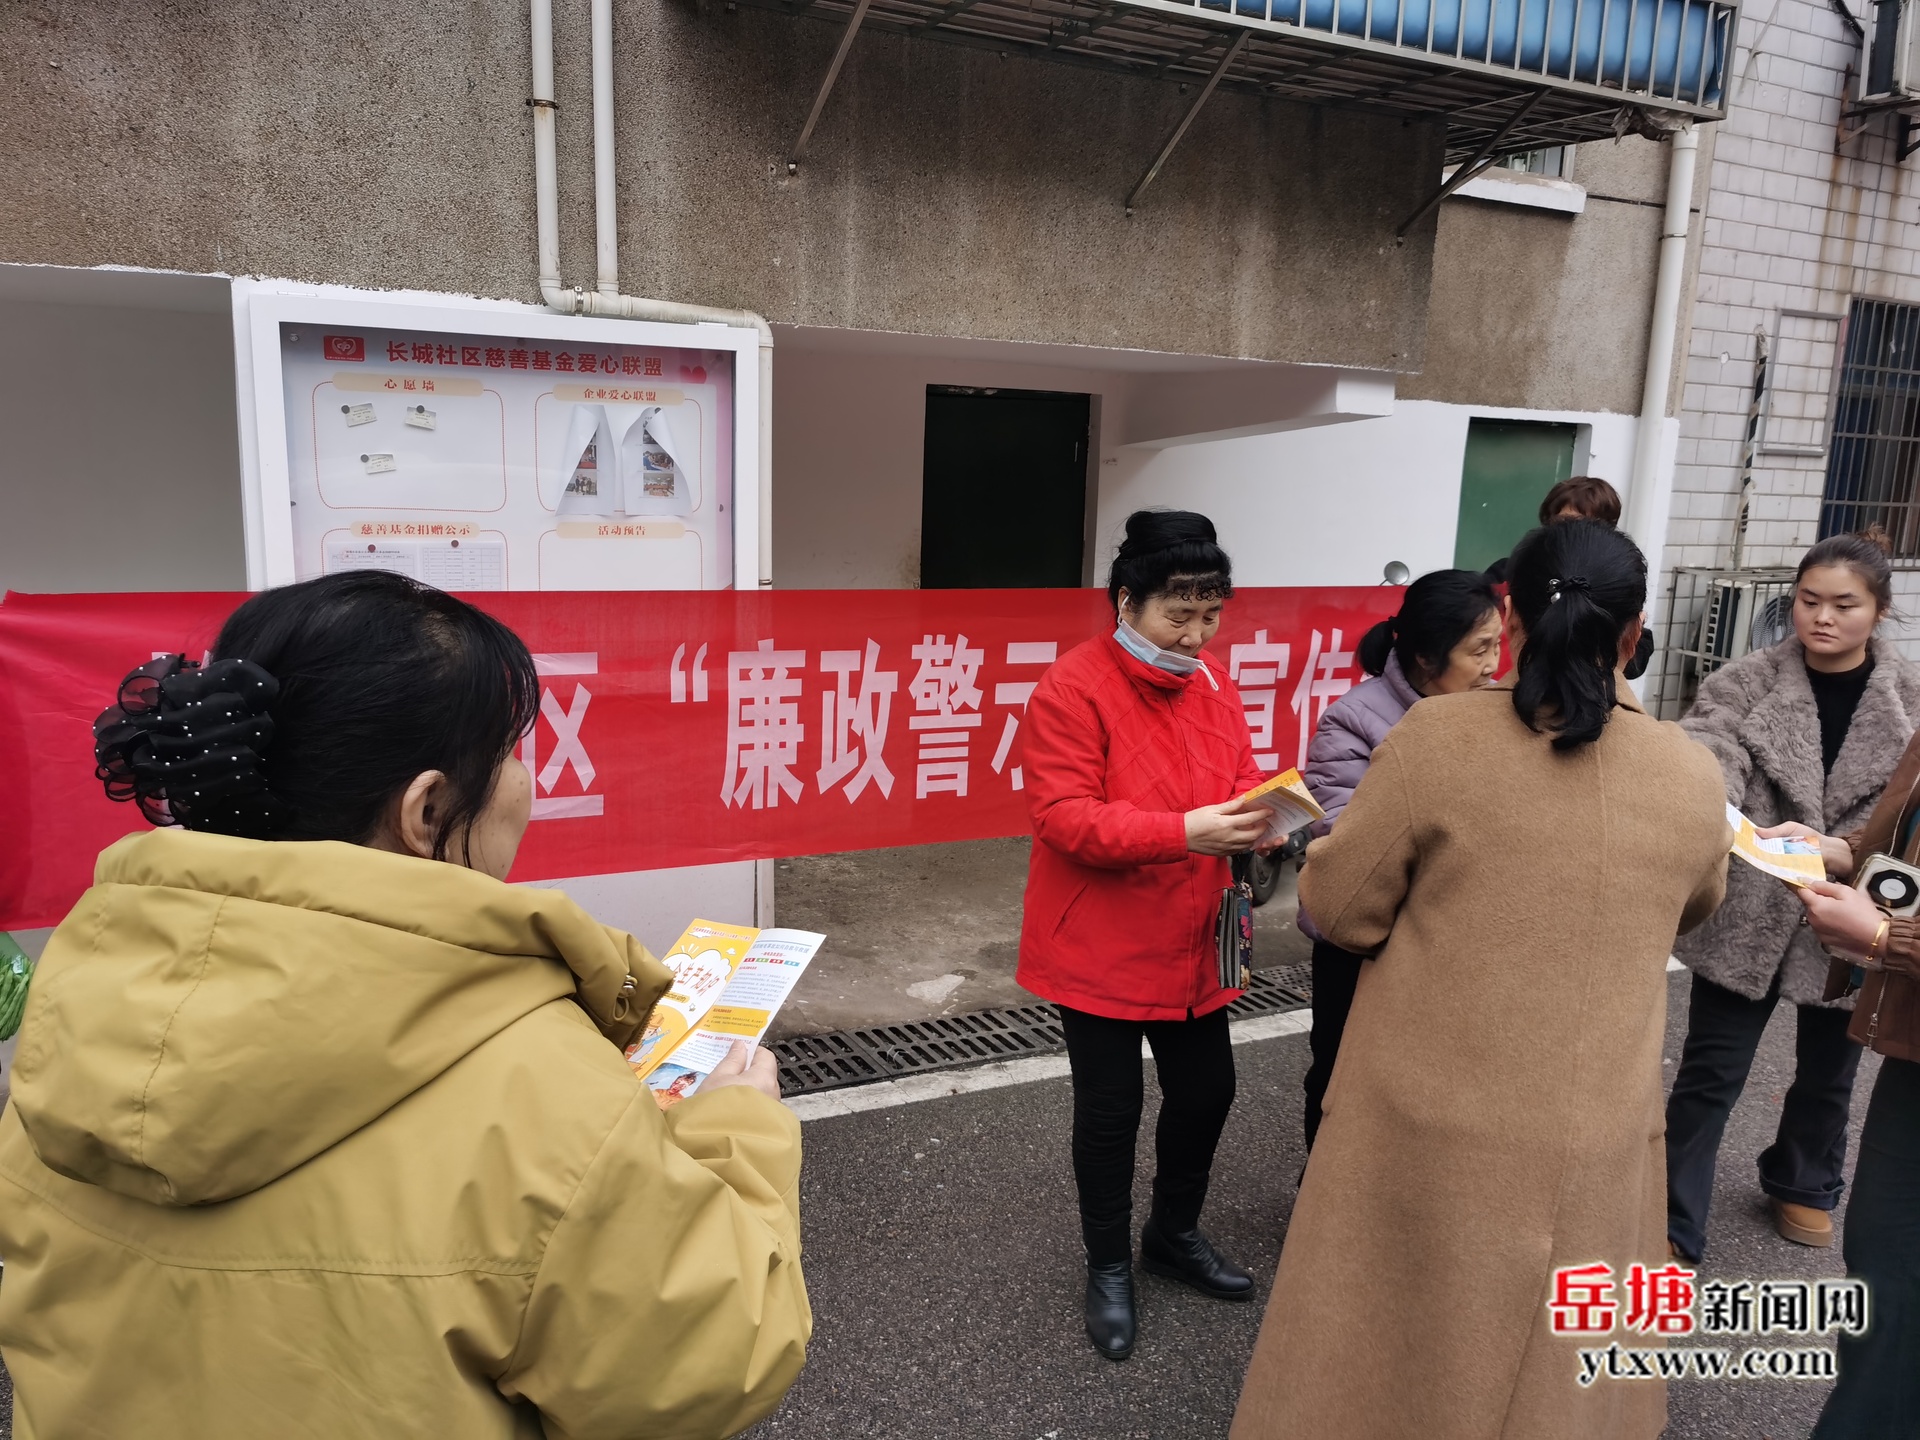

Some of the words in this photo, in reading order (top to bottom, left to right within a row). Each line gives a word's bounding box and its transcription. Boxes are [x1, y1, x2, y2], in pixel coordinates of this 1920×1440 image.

[386, 340, 663, 376] 长城社区慈善基金爱心联盟
[384, 378, 435, 392] 心愿墙
[583, 388, 656, 402] 企业爱心联盟
[360, 523, 471, 535] 慈善基金捐赠公示
[598, 525, 646, 536] 活动预告
